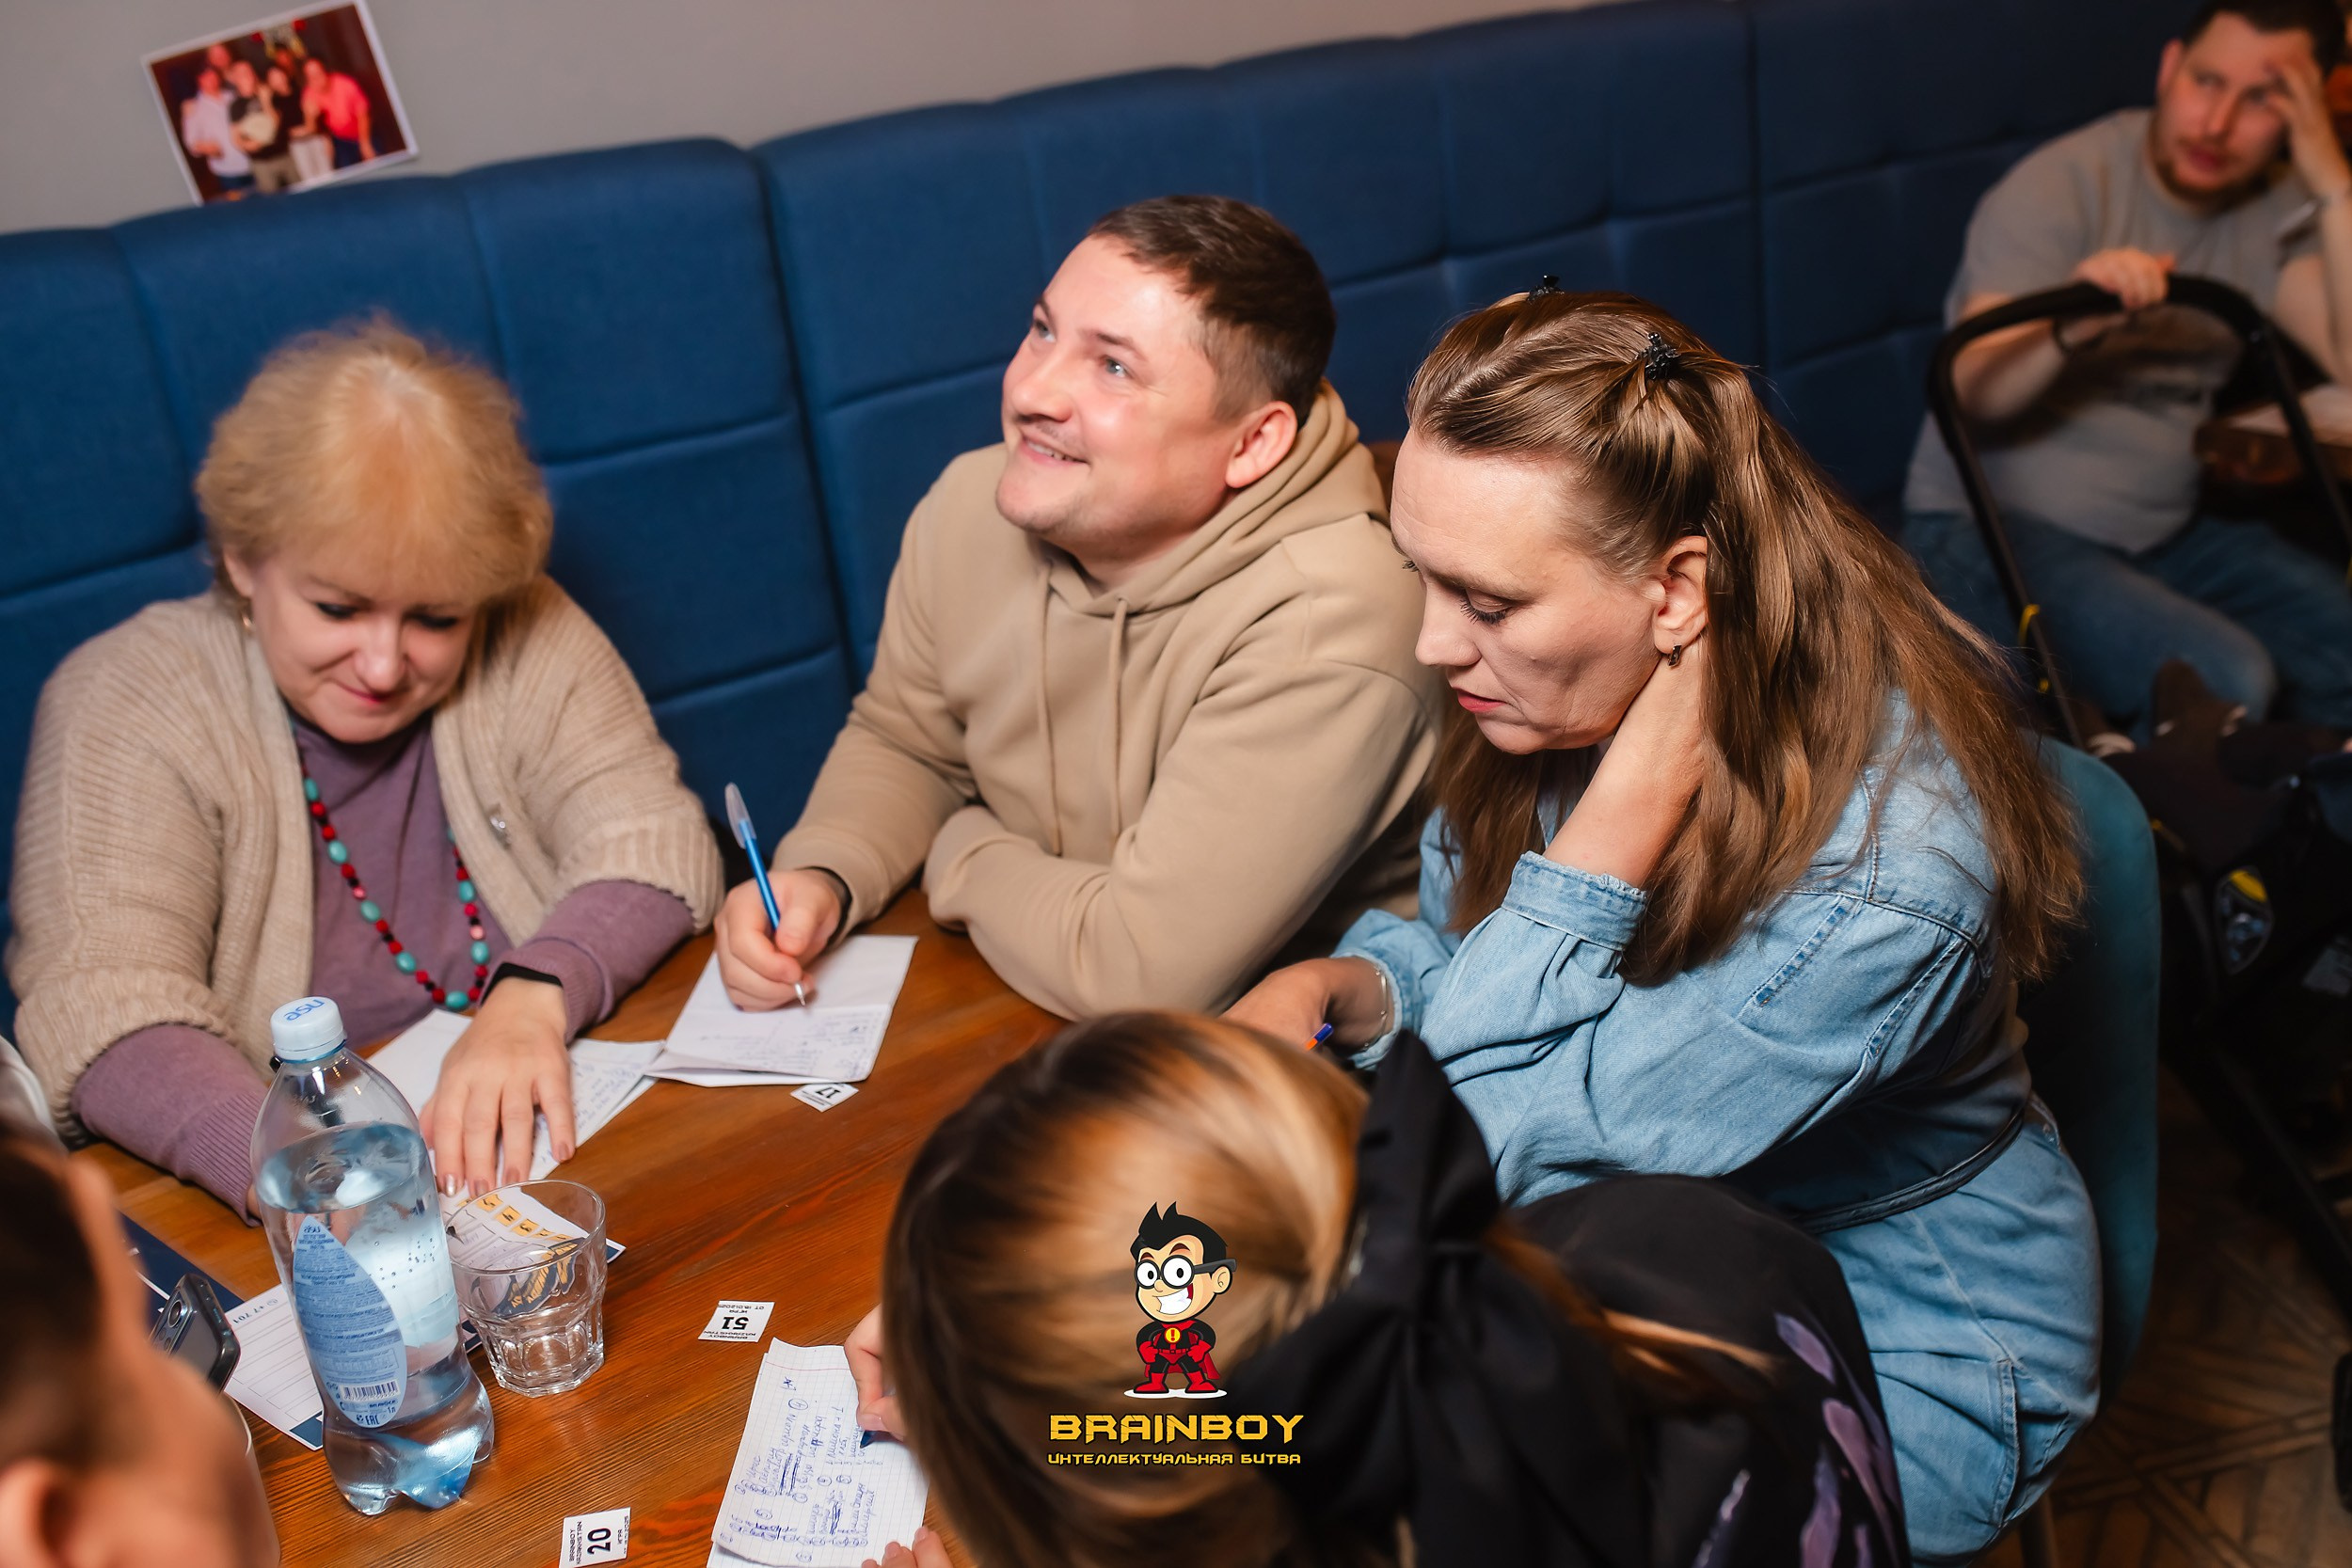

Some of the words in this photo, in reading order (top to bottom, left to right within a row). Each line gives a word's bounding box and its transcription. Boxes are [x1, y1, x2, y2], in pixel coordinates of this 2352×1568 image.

[284, 999, 326, 1022] asu
[815, 1086, 841, 1099] 17
[722, 1316, 750, 1330] 51
[587, 1528, 612, 1555] 20
